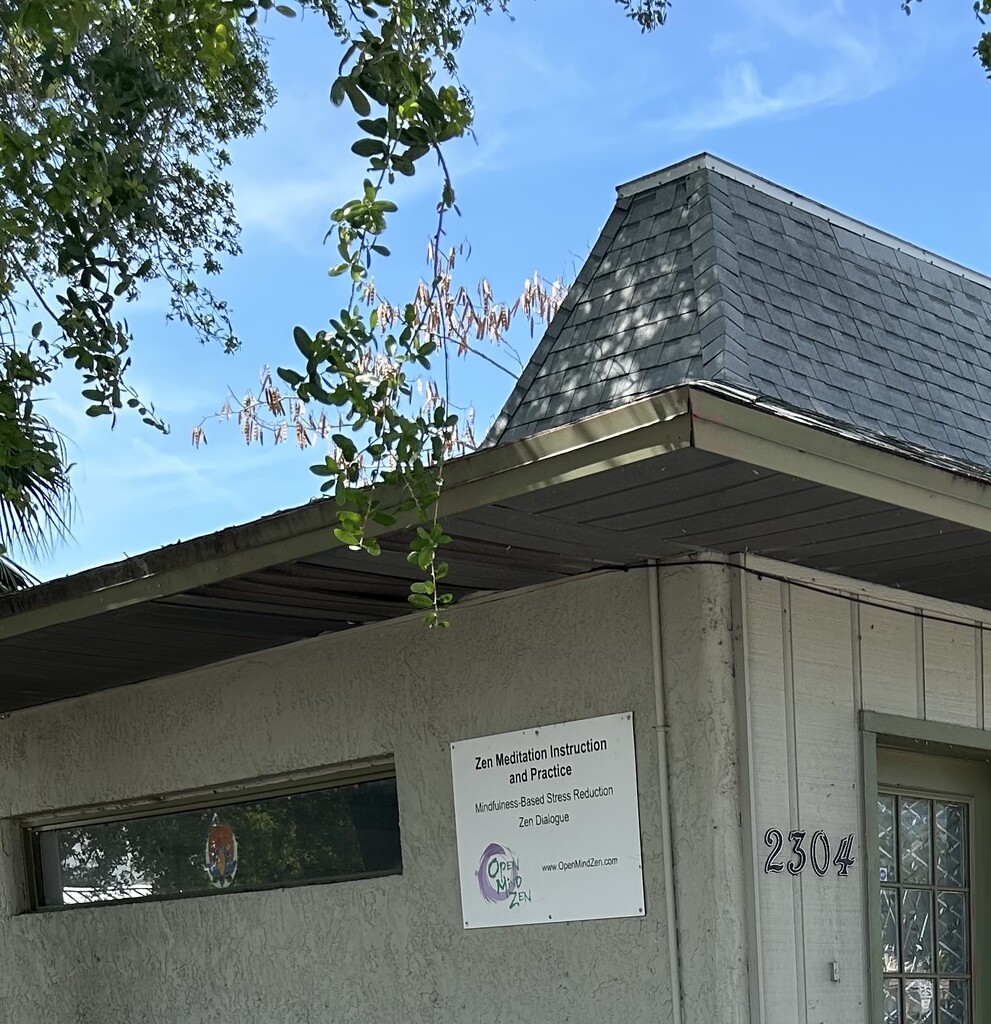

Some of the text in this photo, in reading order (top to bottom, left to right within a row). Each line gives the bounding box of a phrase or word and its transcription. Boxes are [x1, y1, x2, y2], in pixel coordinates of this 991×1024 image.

[475, 738, 607, 770] Zen Meditation Instruction
[509, 764, 572, 784] and Practice
[475, 785, 614, 813] Mindfulness-Based Stress Reduction
[519, 813, 570, 828] Zen Dialogue
[541, 857, 619, 872] www.OpenMindZen.com
[764, 828, 855, 877] 2304
